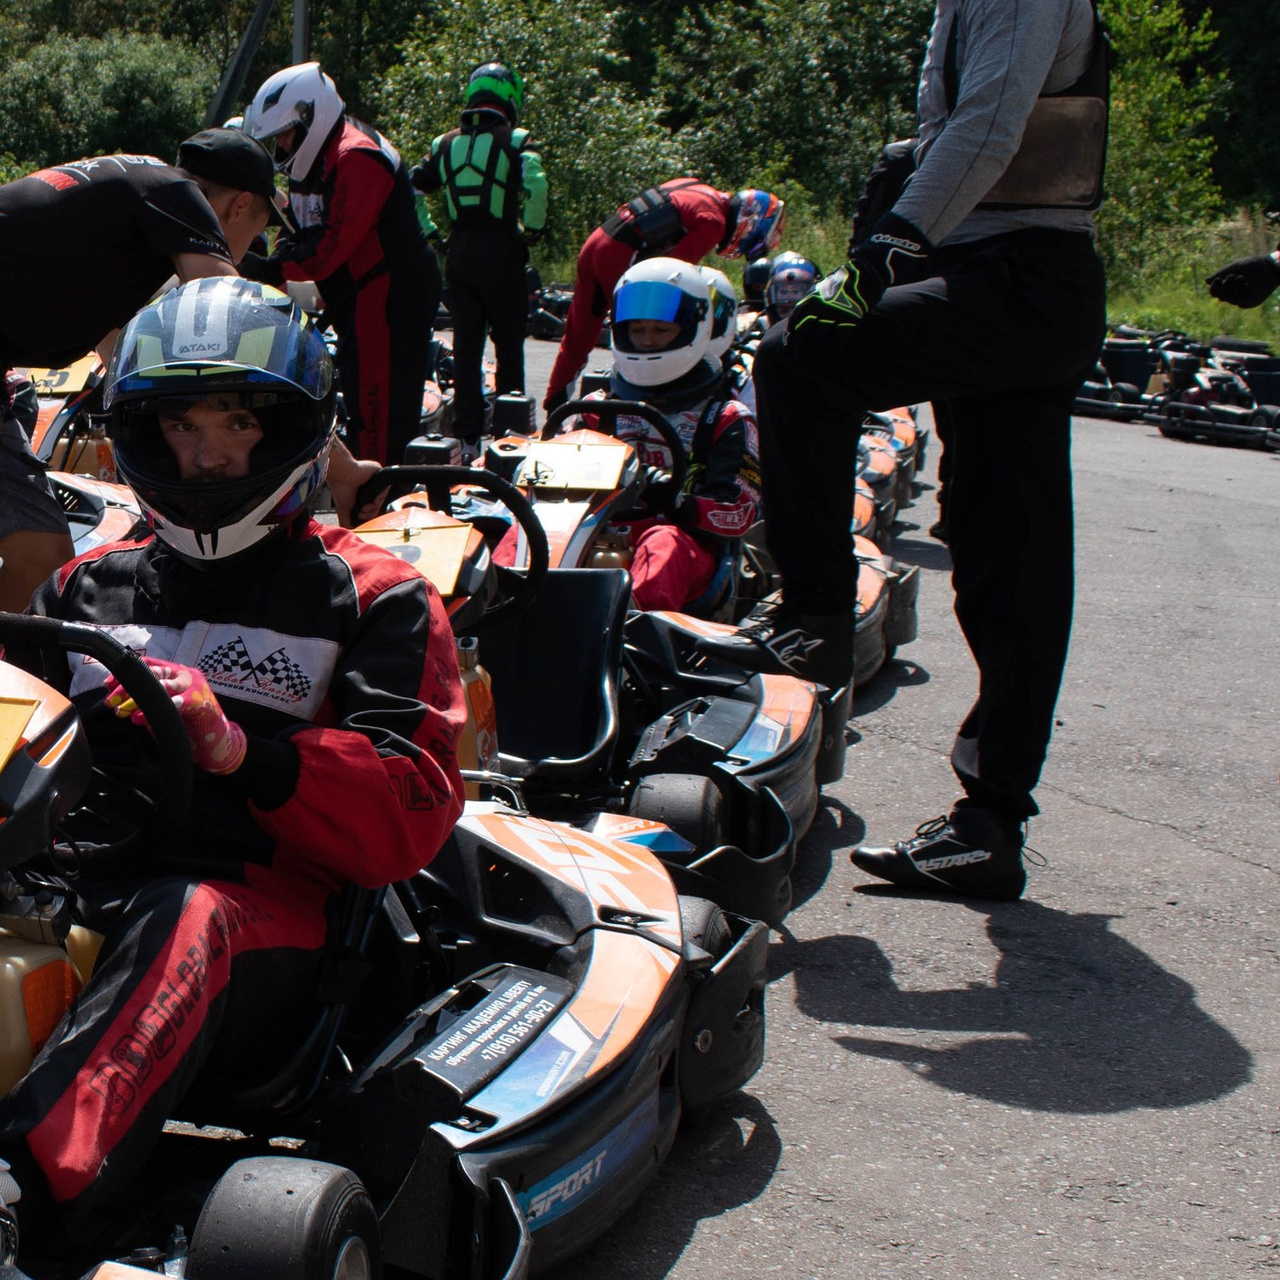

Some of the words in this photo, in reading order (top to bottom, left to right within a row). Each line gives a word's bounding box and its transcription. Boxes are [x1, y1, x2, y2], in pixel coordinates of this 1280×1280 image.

[179, 343, 221, 354] ATAKI
[428, 1030, 469, 1061] КАРТИНГ
[461, 996, 508, 1034] АКАДЕМИЯ
[480, 1031, 522, 1061] +7(916)
[507, 999, 556, 1037] 561-90-27
[526, 1149, 608, 1224] SPORT
